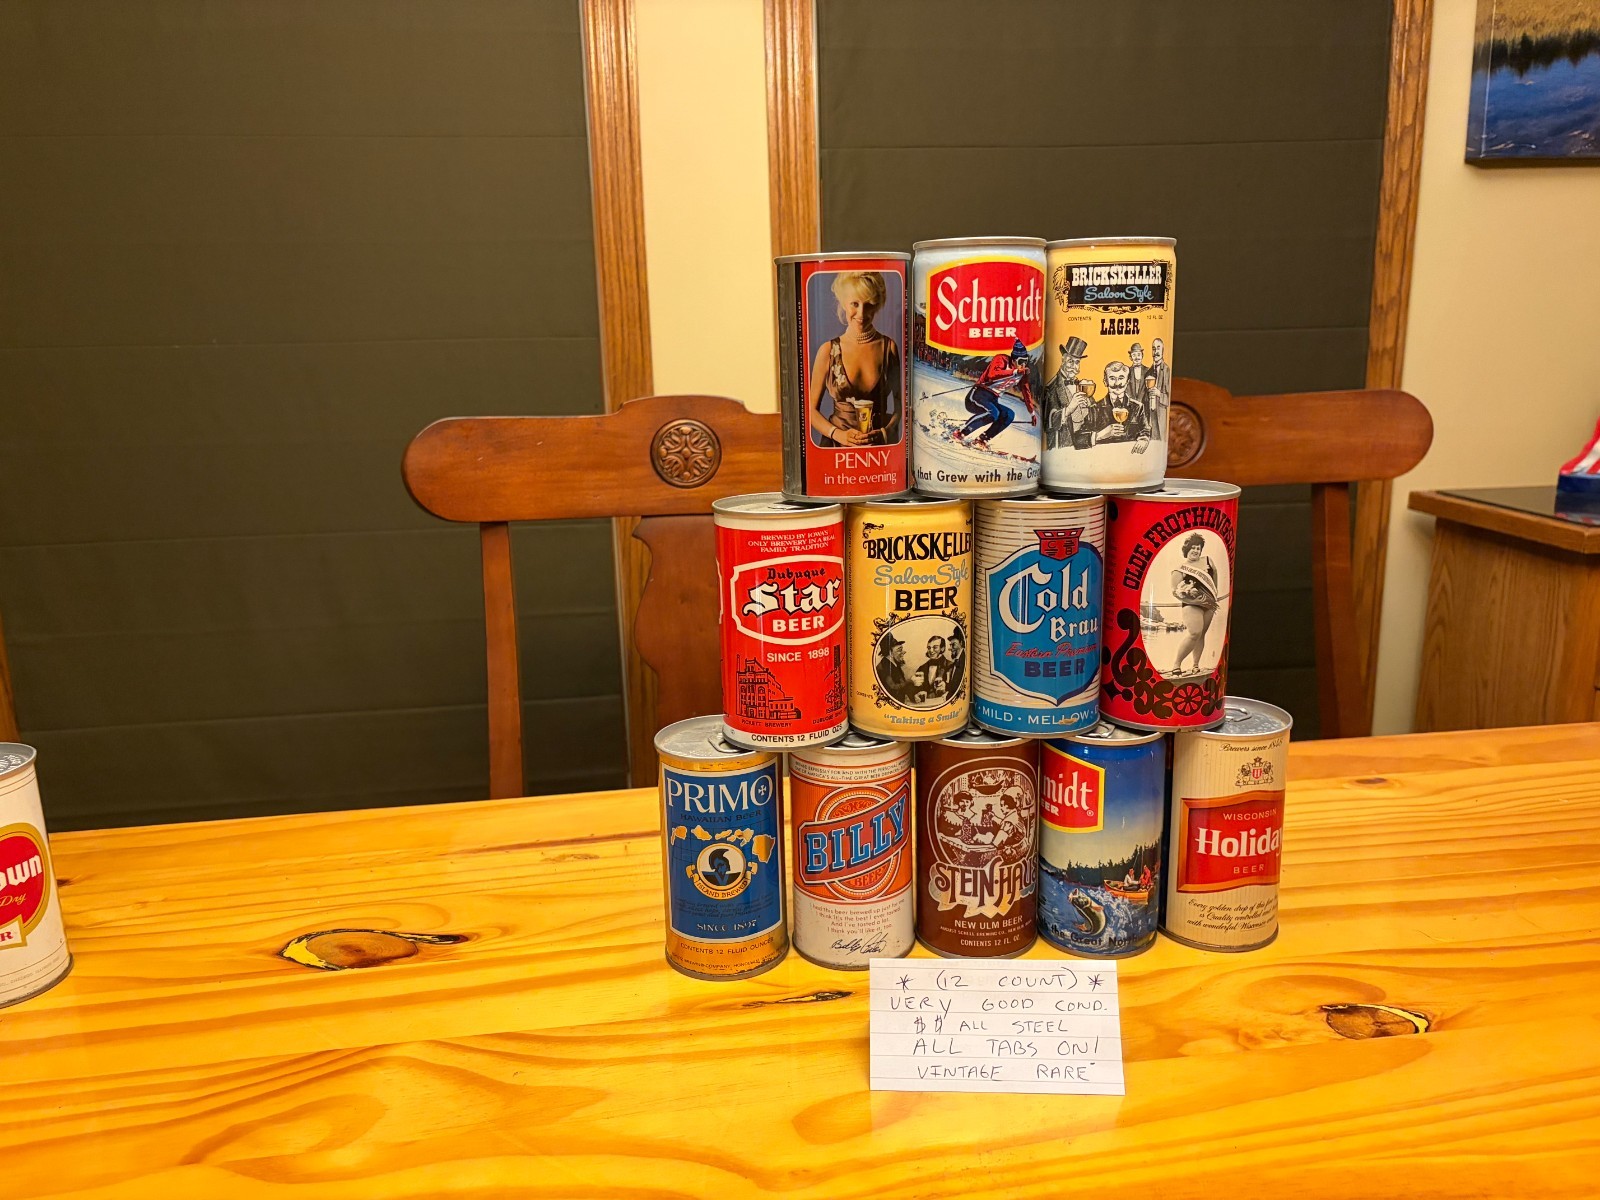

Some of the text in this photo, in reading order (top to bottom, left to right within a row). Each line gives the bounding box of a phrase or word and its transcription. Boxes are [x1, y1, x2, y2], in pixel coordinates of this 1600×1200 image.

[1072, 264, 1162, 286] BRICKSKELLER
[1084, 285, 1154, 302] Saloon Style
[935, 276, 1041, 331] Schmidt
[968, 326, 1016, 338] BEER
[1100, 318, 1140, 336] LAGER
[835, 450, 890, 468] PENNY
[824, 471, 896, 485] in the evening
[917, 467, 1022, 482] that Grew with the
[790, 542, 829, 552] TRADITION
[767, 568, 826, 580] Dubuque
[874, 559, 969, 586] Saloon Style
[1122, 543, 1154, 590] OLDE
[742, 576, 842, 618] Star
[895, 586, 958, 611] BEER
[998, 560, 1089, 634] Cold
[772, 616, 825, 632] BEER
[1050, 615, 1098, 642] Brau
[766, 647, 830, 663] SINCE 1898
[1024, 658, 1085, 678] BEER
[982, 706, 1013, 722] MILD
[752, 734, 794, 742] CONTENTS
[810, 729, 829, 740] FLUID
[1220, 742, 1250, 752] Brewers
[666, 775, 773, 813] PRIMO
[1043, 771, 1093, 810] midt
[680, 810, 762, 822] HAWAIIAN BEER
[1042, 798, 1059, 816] EER
[1223, 808, 1277, 820] WISCONSIN
[806, 794, 906, 872] BILLY
[1195, 827, 1282, 858] Holida
[855, 868, 882, 887] BEER
[1234, 864, 1264, 874] BEER
[697, 880, 748, 898] ISLAND BREWED
[1188, 898, 1207, 912] Every
[1207, 904, 1232, 913] golden
[1234, 904, 1248, 914] drop
[954, 915, 1023, 930] NEW ULM BEER
[1207, 912, 1233, 924] Quality
[1235, 910, 1262, 920] controlled
[1051, 924, 1064, 939] the
[1070, 932, 1102, 945] Great
[1203, 923, 1238, 933] wonderful
[680, 942, 714, 954] CONTENTS
[751, 936, 774, 950] OUNCES
[936, 967, 1078, 990] (12 COUNT)
[890, 996, 1107, 1019] VERY GOOD COND.
[960, 1020, 988, 1031] ALL
[1012, 1020, 1068, 1034] STEEL
[913, 1038, 963, 1055] ALL
[986, 1039, 1038, 1057] TABS
[918, 1064, 1090, 1081] VINTAGE RARE
